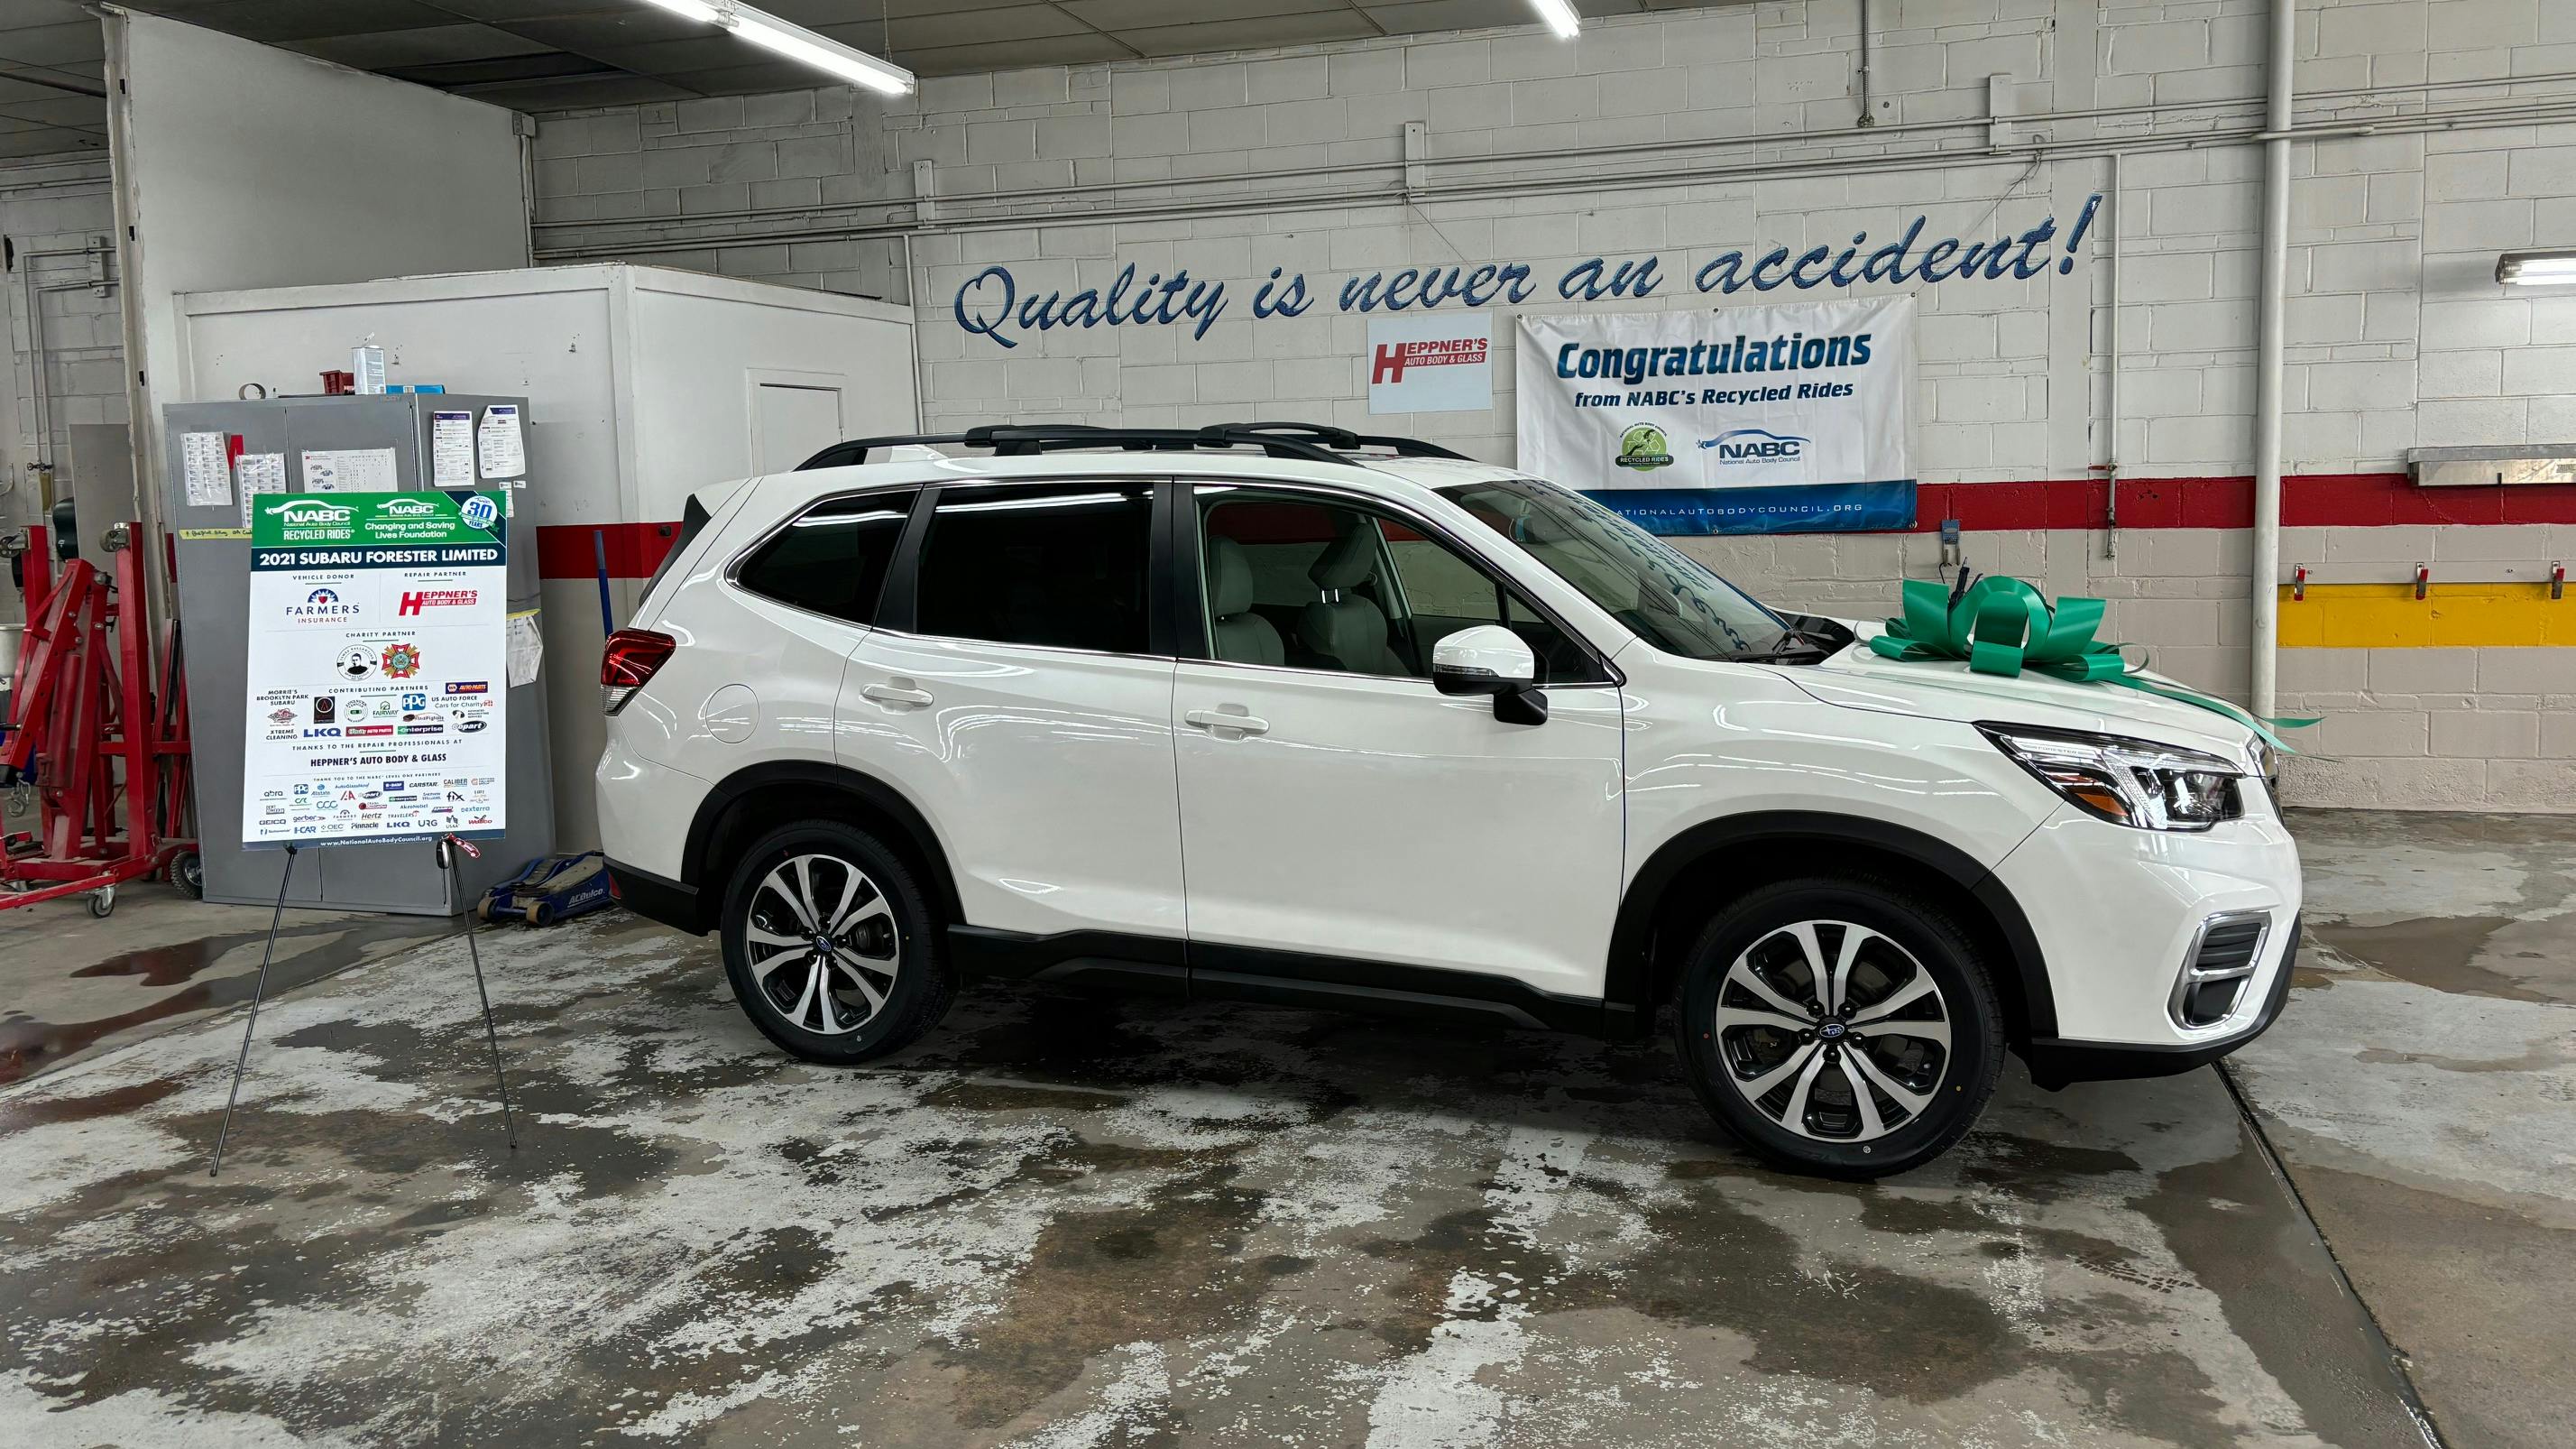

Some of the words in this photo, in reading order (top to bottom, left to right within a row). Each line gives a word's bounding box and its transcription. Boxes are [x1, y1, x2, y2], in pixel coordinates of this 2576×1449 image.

[954, 262, 1228, 349] Quality
[1253, 265, 1316, 318] is
[1339, 262, 1537, 313] never
[1558, 254, 1663, 302] an
[1695, 192, 2102, 295] accident!
[1372, 337, 1488, 384] HEPPNER'S
[1404, 356, 1425, 366] AUTO
[1427, 355, 1448, 365] BODY
[1449, 355, 1456, 364] &
[1457, 353, 1483, 364] GLASS
[1556, 332, 1872, 385] Congratulations
[1574, 390, 1622, 408] from
[1625, 388, 1696, 408] NABC's
[1700, 383, 1792, 406] Recycled
[1796, 381, 1854, 401] Rides
[1719, 440, 1800, 459] NABC
[284, 509, 351, 522] NABC
[389, 505, 434, 514] NABC
[467, 501, 492, 520] 30
[1617, 503, 1863, 516] ATIONALAUTOBODYCOUNCIL.ORG
[364, 522, 406, 532] Changing
[408, 522, 424, 531] and
[425, 521, 455, 531] Saving
[283, 529, 325, 540] RECYCLED
[375, 531, 398, 540] Lives
[399, 530, 447, 539] Foundation
[259, 552, 296, 567] 2021
[299, 551, 363, 565] SUBARU
[365, 549, 437, 564] FORESTER
[441, 549, 498, 561] LIMITED
[399, 589, 478, 616] HEPPNER'S
[286, 605, 360, 616] FARMERS
[328, 686, 387, 694] CONTRIBUTING
[402, 695, 426, 710] PPG
[303, 727, 342, 738] LKQ
[388, 739, 450, 747] PROFESSIONALS
[310, 756, 358, 767] HEPPNER'S
[359, 755, 383, 765] AUTO
[385, 754, 409, 763] BODY
[411, 754, 419, 762] &
[420, 752, 446, 761] GLASS
[351, 821, 379, 830] Pinnacle
[418, 819, 438, 827] URG
[320, 835, 433, 846] www.NationalAutoBodyCouncil.org
